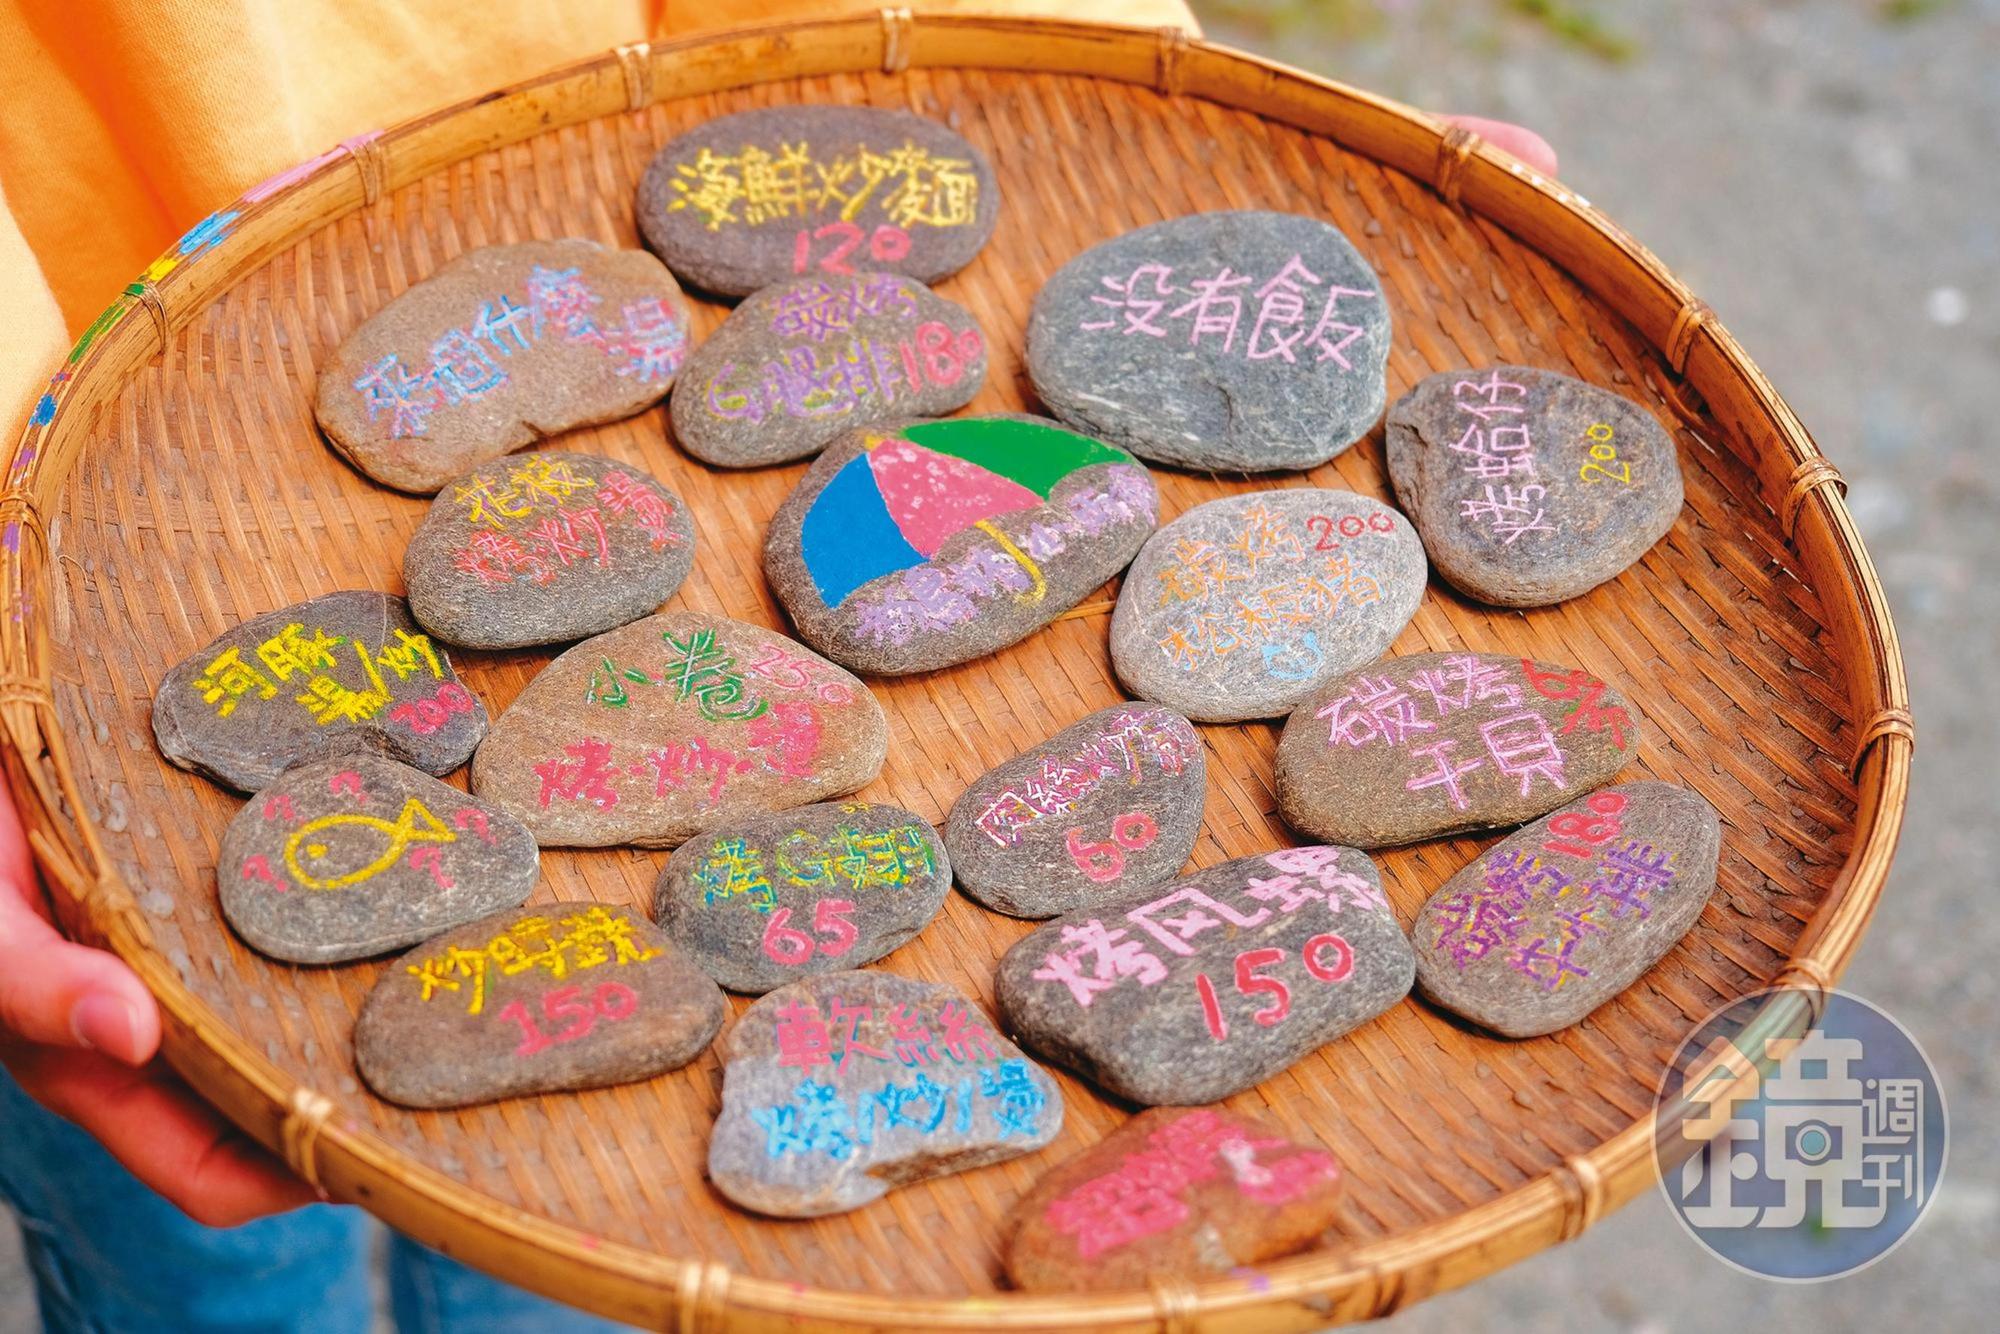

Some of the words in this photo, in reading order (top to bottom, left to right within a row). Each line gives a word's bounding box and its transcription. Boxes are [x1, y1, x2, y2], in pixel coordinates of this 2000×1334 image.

[793, 221, 912, 275] 120
[899, 321, 986, 394] 180
[1579, 422, 1631, 484] 200
[1306, 511, 1396, 551] 200
[751, 644, 856, 704] 250
[1066, 811, 1158, 883] 60
[1542, 792, 1629, 859] 180
[763, 900, 860, 966] 65
[500, 981, 638, 1058] 150
[1195, 933, 1354, 1042] 150
